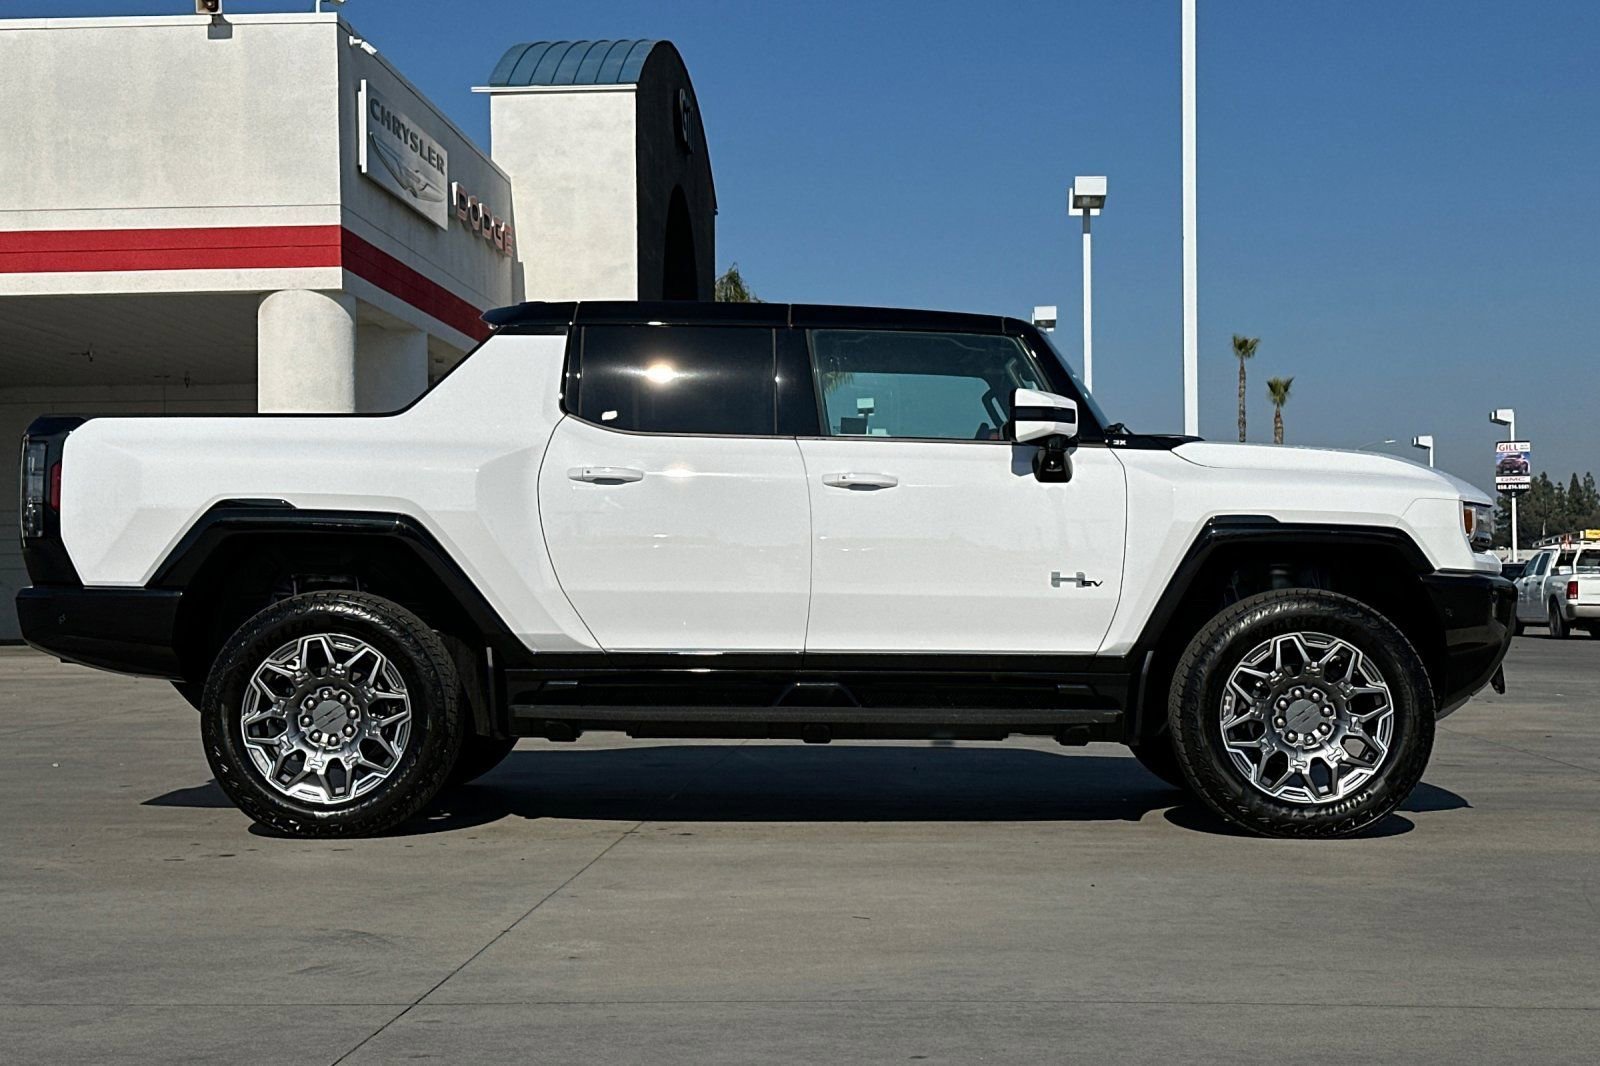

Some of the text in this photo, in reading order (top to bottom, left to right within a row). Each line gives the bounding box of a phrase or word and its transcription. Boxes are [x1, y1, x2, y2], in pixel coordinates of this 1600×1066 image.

[369, 98, 445, 175] CHRYSLER
[452, 181, 513, 257] DODGE
[1498, 443, 1519, 451] GILL
